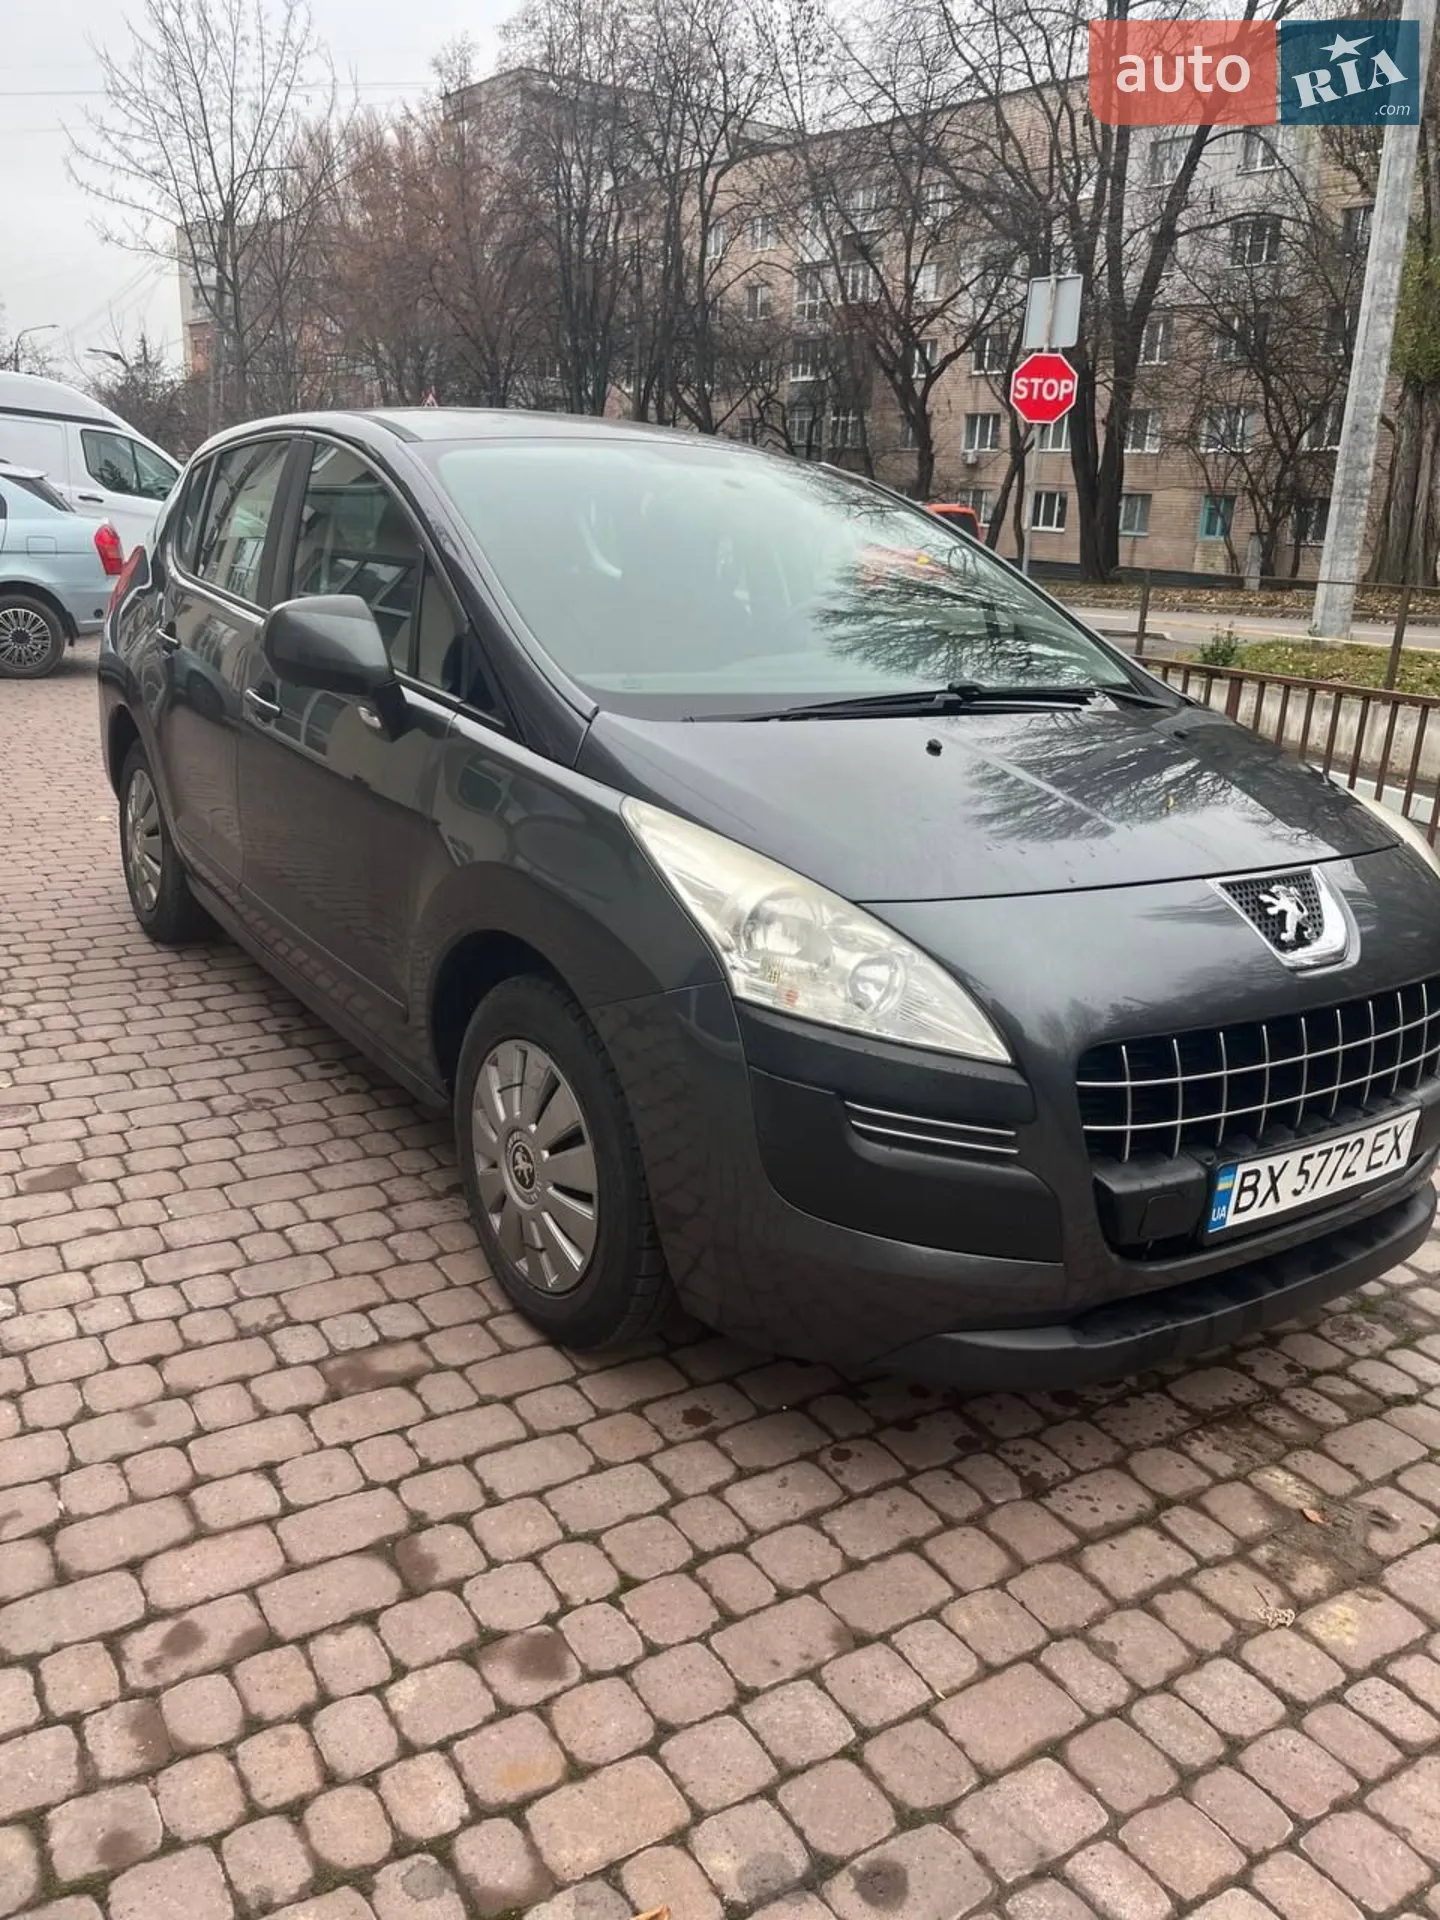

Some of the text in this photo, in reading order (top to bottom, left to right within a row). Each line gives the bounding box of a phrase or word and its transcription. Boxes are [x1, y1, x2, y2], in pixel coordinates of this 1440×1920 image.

[1013, 377, 1074, 401] STOP
[1233, 1119, 1411, 1215] BX 5772 EX
[1211, 1206, 1227, 1222] UA
